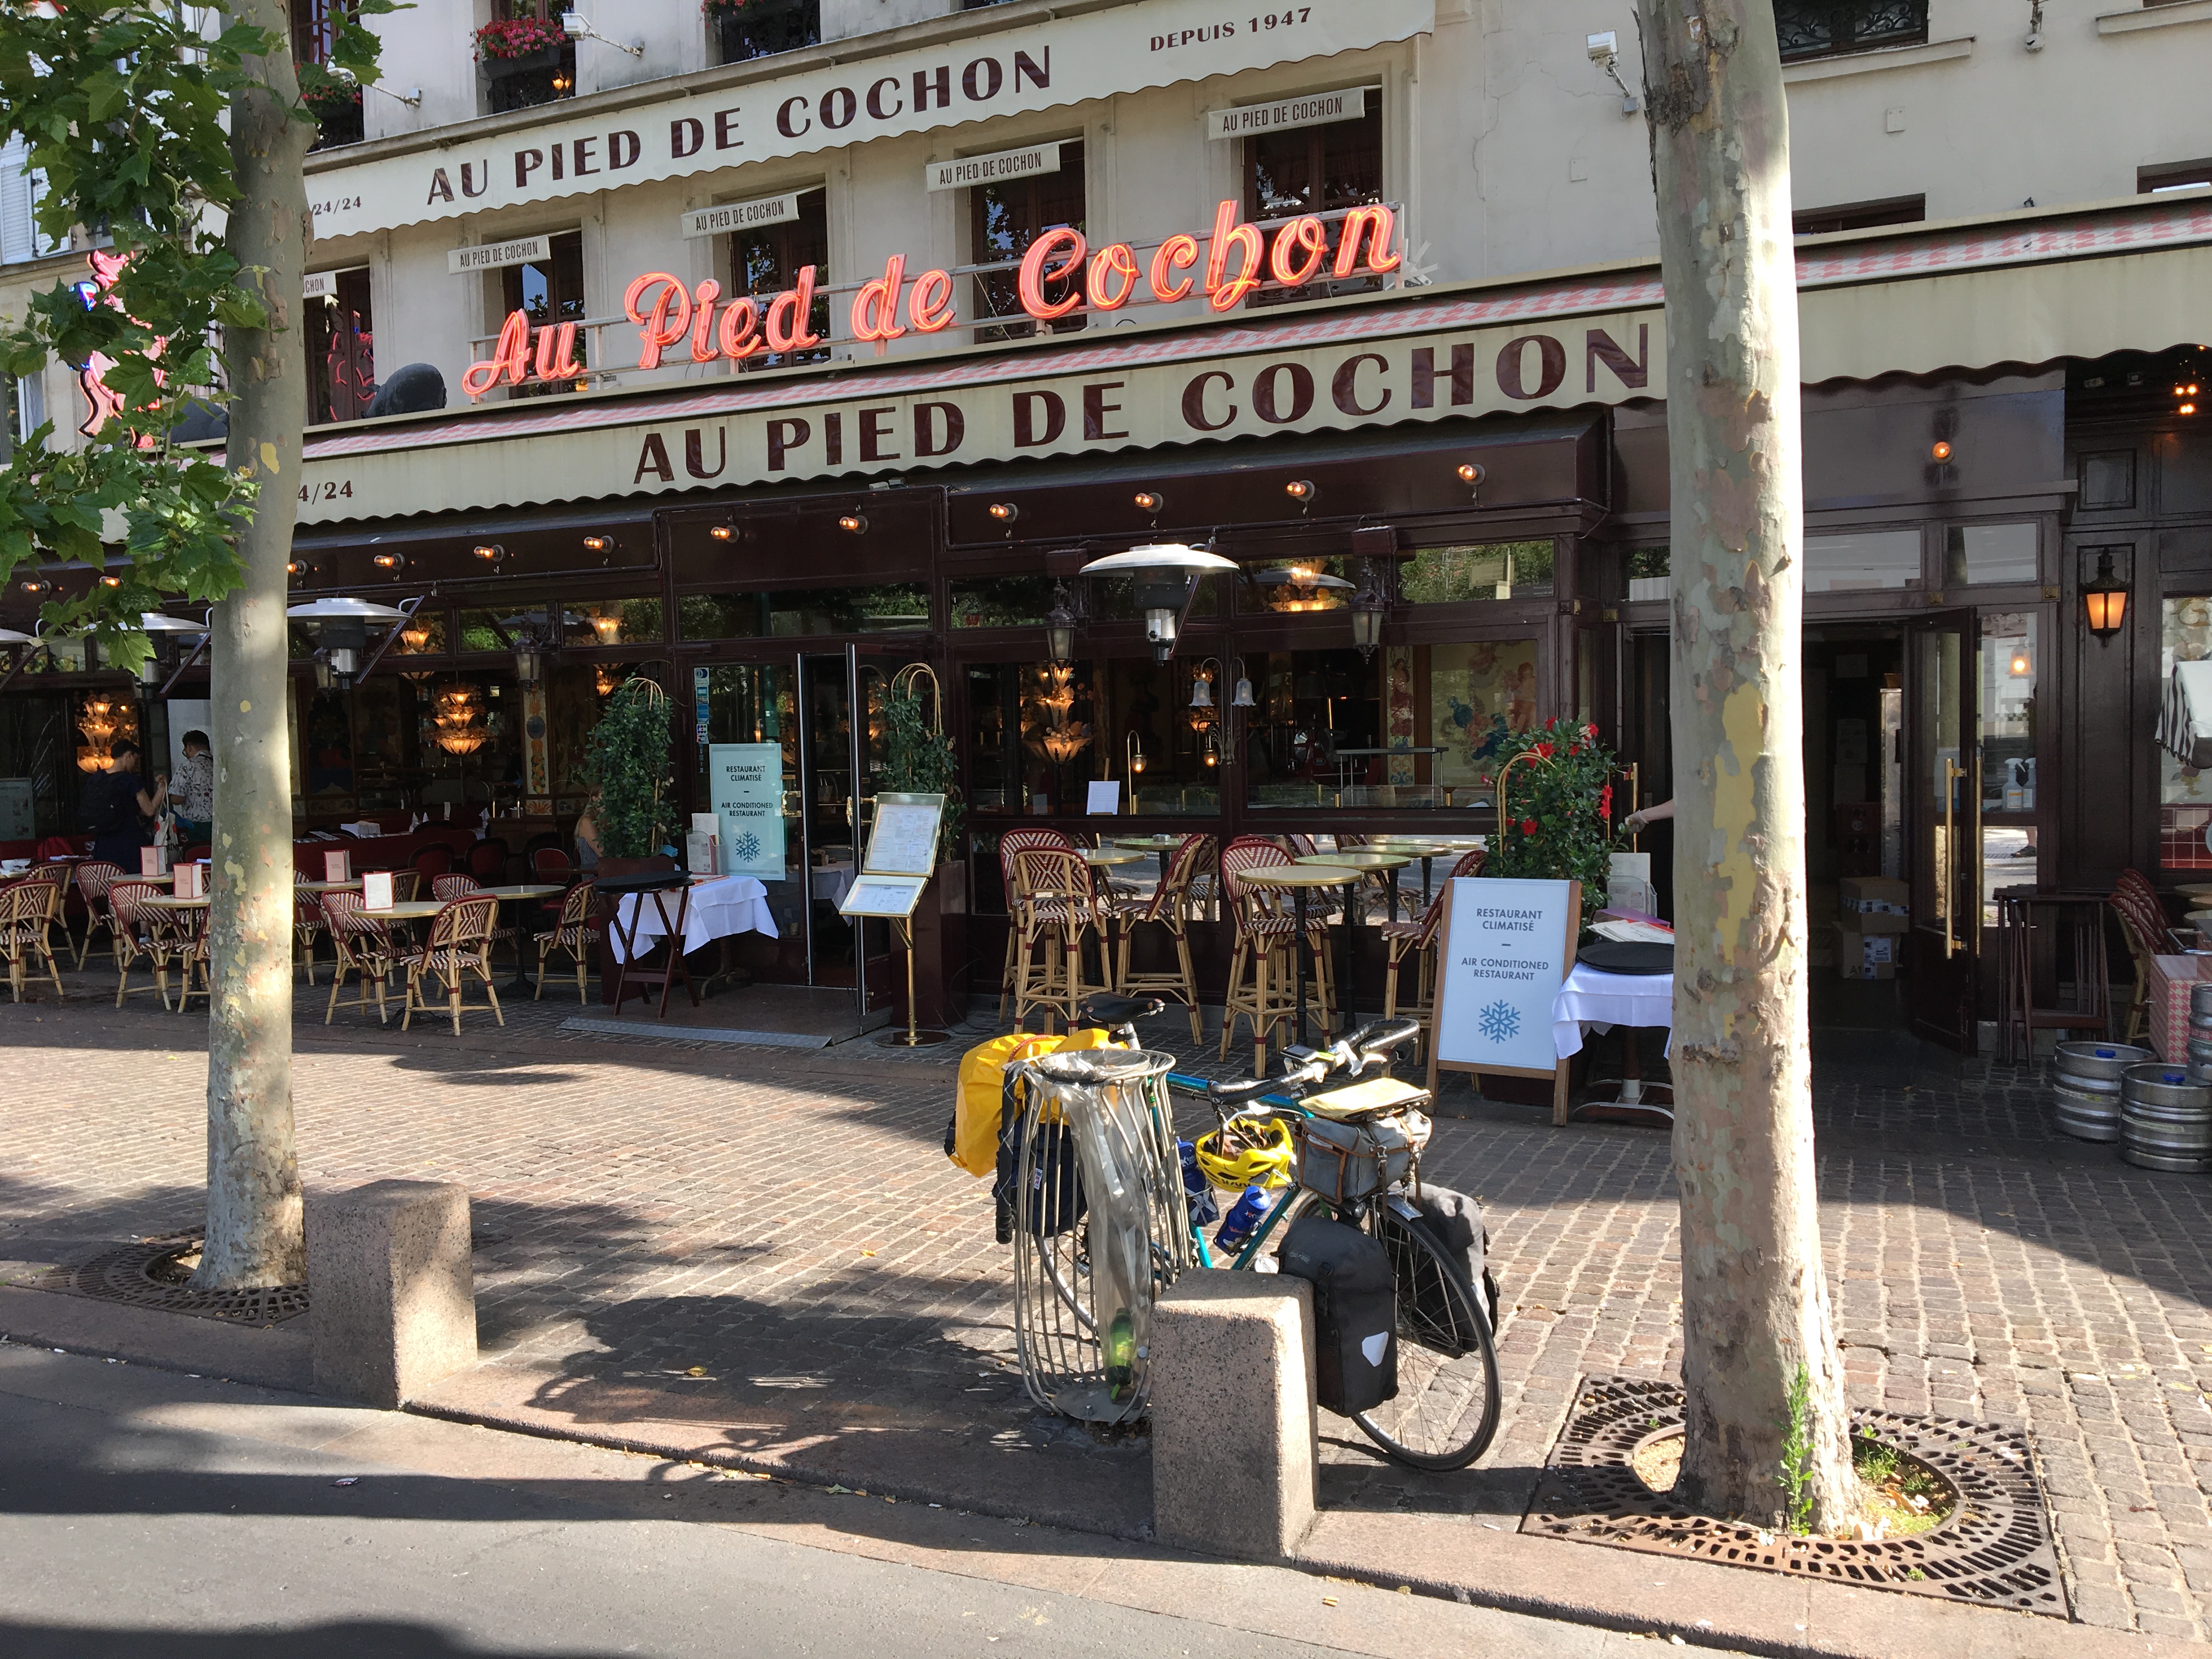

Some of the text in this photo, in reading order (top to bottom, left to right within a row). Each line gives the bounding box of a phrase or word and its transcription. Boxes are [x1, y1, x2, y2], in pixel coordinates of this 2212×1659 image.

[1151, 7, 1311, 51] DEPUIS 1947
[427, 46, 1049, 205] AU PIED DE COCHON
[1223, 97, 1341, 132] AU PIED DE COCHON
[940, 152, 1041, 184] AU PIED DE COCHON
[697, 200, 783, 231] AU PIED DE COCHON
[460, 241, 538, 267] AU PIED DE COCHON
[303, 278, 325, 294] CHON
[461, 200, 1403, 399] Au Pied de Cochon
[634, 324, 1647, 484] AU PIED DE COCHON
[731, 773, 761, 781] CLIMATISÉ
[1477, 909, 1542, 919] RESTAURANT
[1483, 920, 1534, 931] CLIMATISÉ
[1462, 957, 1548, 969] AIR CONDITIONED
[1474, 969, 1534, 980] RESTAURANT
